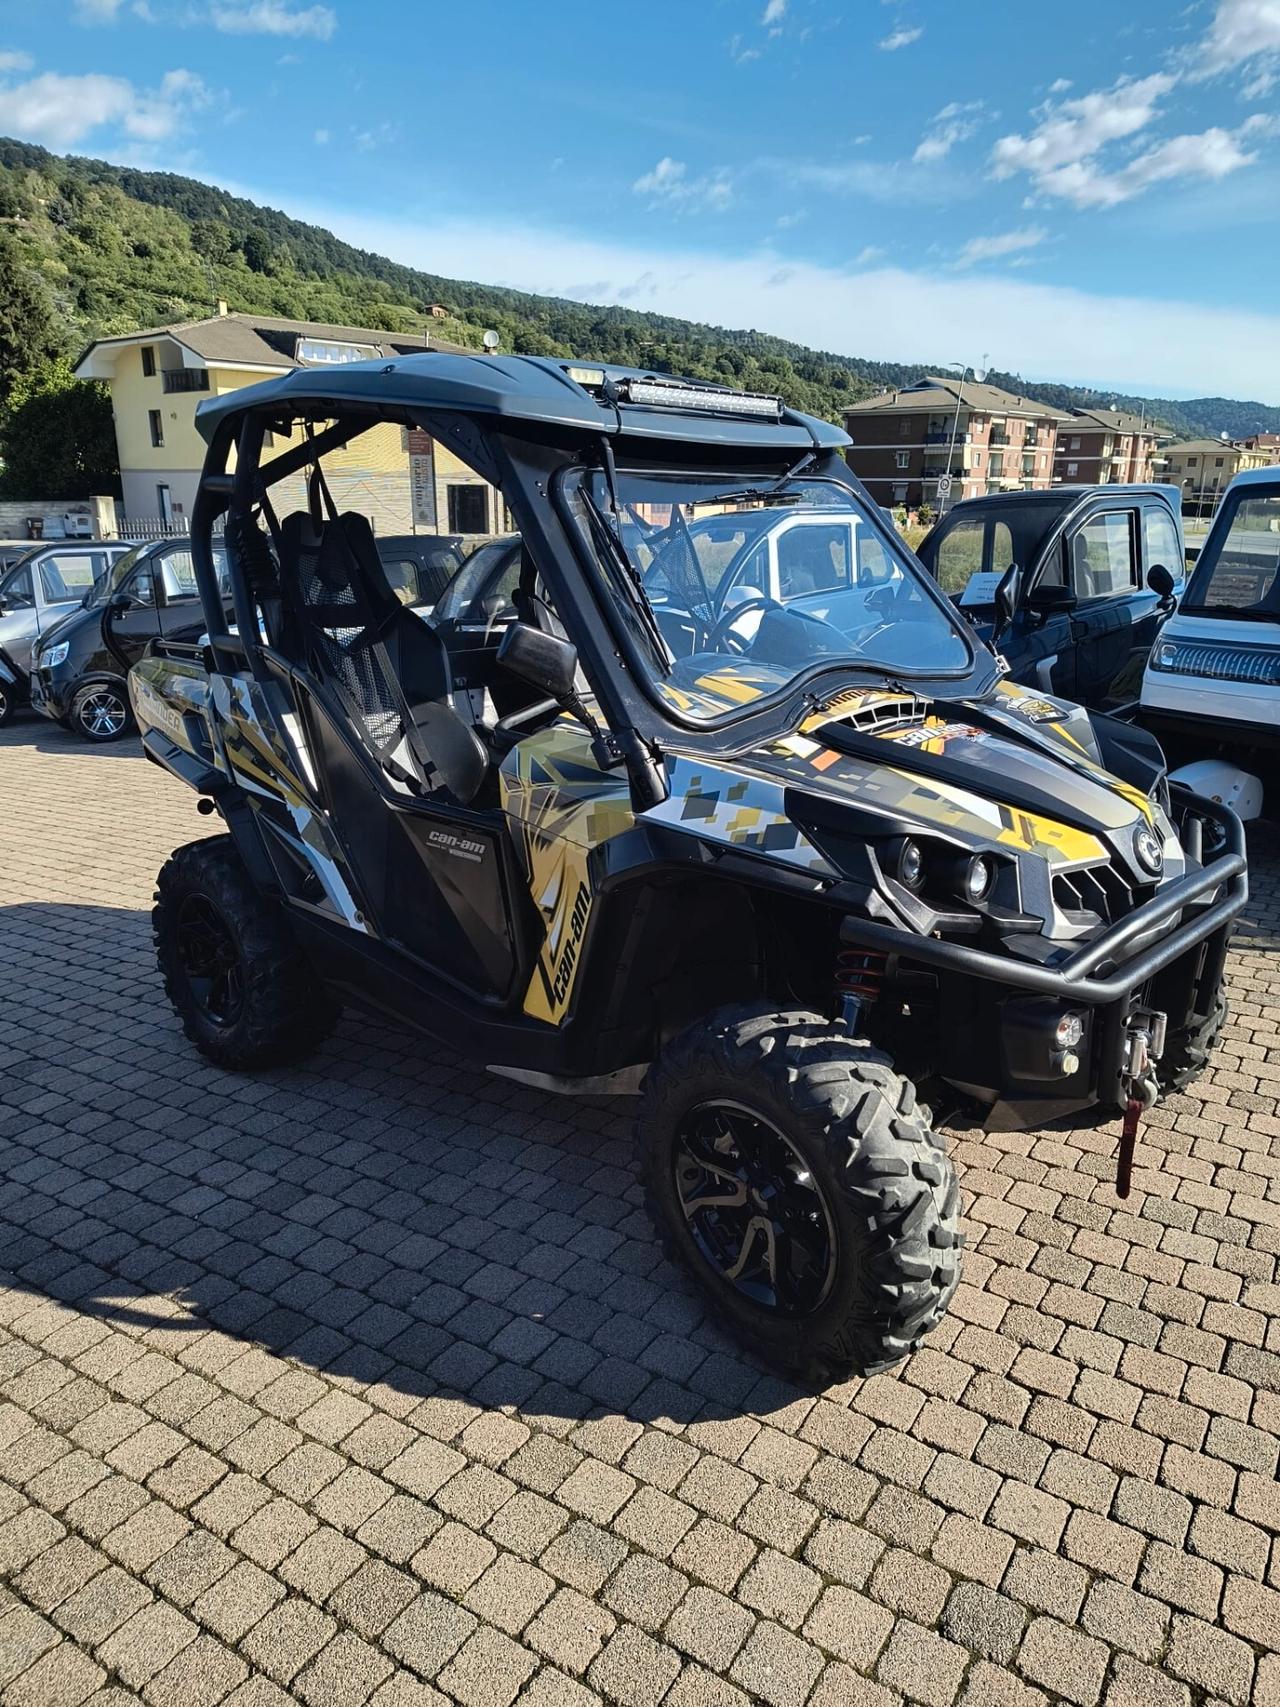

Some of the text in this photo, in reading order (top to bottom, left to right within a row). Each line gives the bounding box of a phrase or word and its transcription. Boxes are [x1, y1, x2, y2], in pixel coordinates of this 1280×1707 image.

[414, 459, 425, 507] emporio
[429, 831, 485, 854] can-am
[554, 881, 590, 1005] can-am
